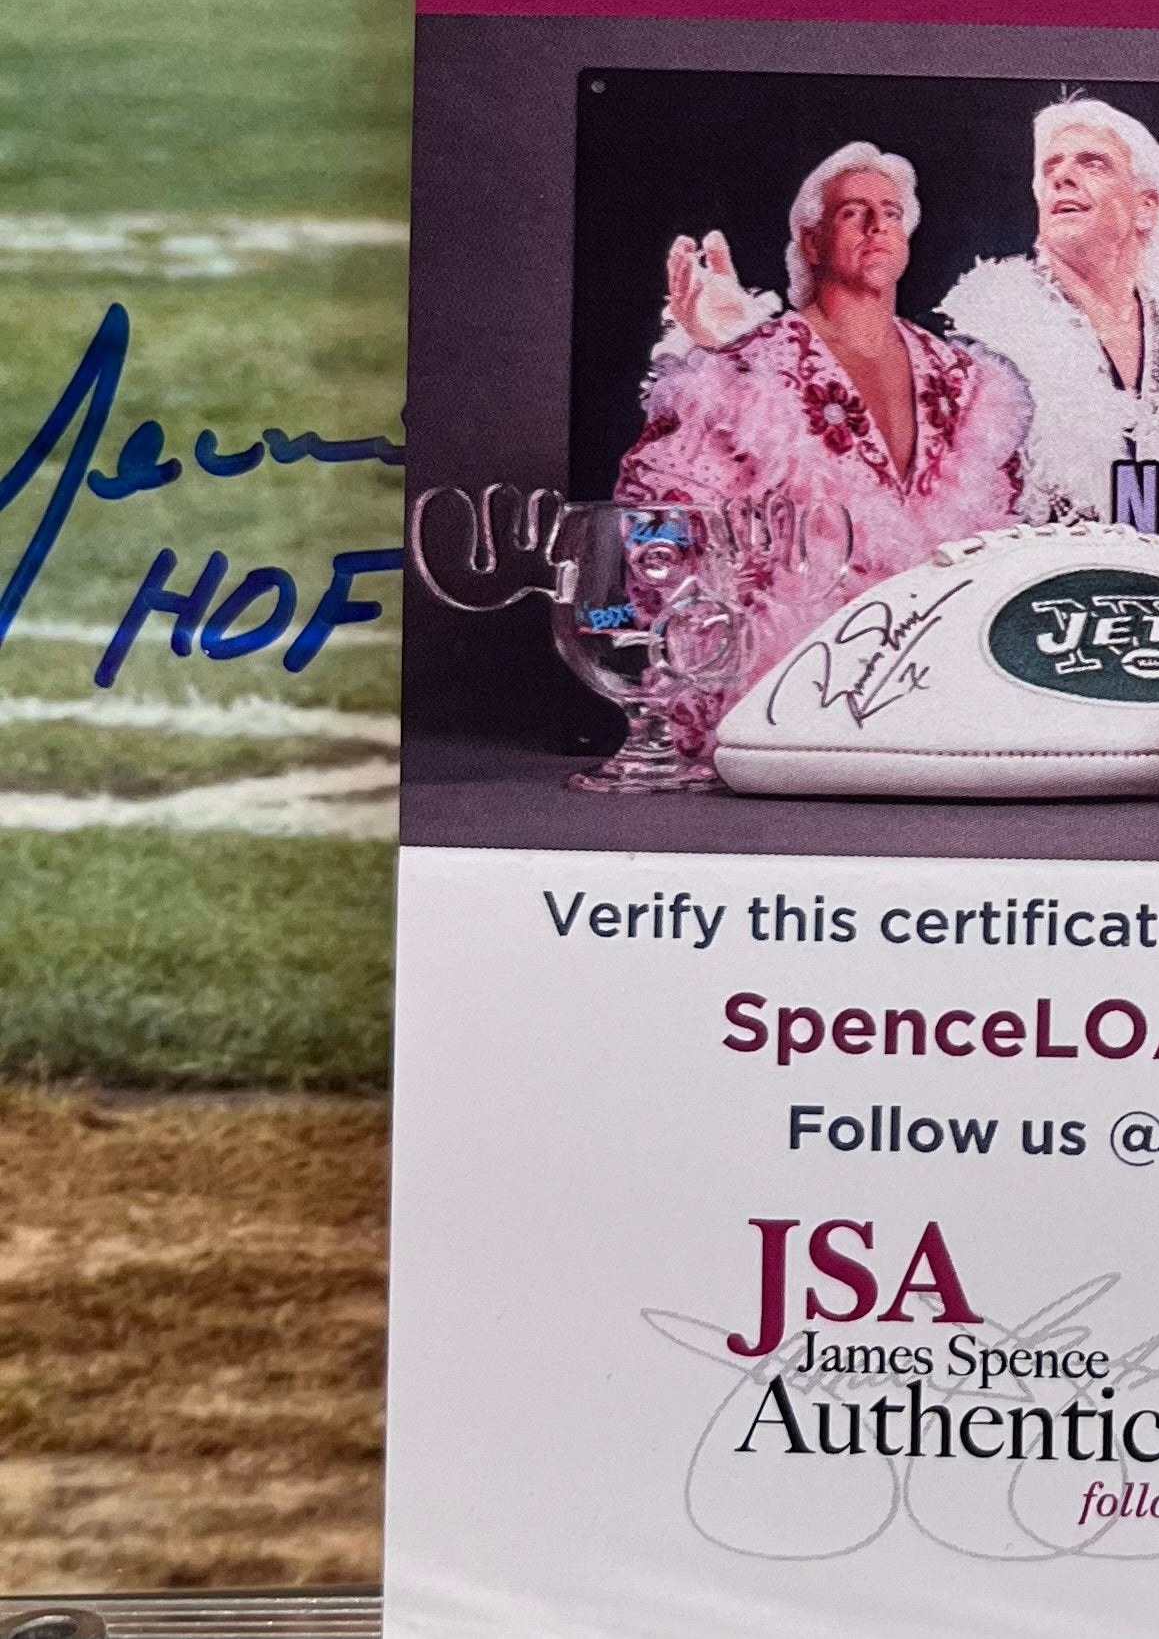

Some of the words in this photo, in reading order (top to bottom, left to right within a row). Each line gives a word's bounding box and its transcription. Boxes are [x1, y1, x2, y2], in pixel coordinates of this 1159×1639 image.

[94, 546, 405, 689] HOF
[543, 890, 726, 950] Verify
[747, 893, 857, 943] this
[788, 1105, 998, 1154] Follow
[1022, 1120, 1087, 1156] us
[726, 1218, 984, 1358] JSA
[796, 1330, 933, 1376] James
[946, 1334, 1110, 1390] Spence
